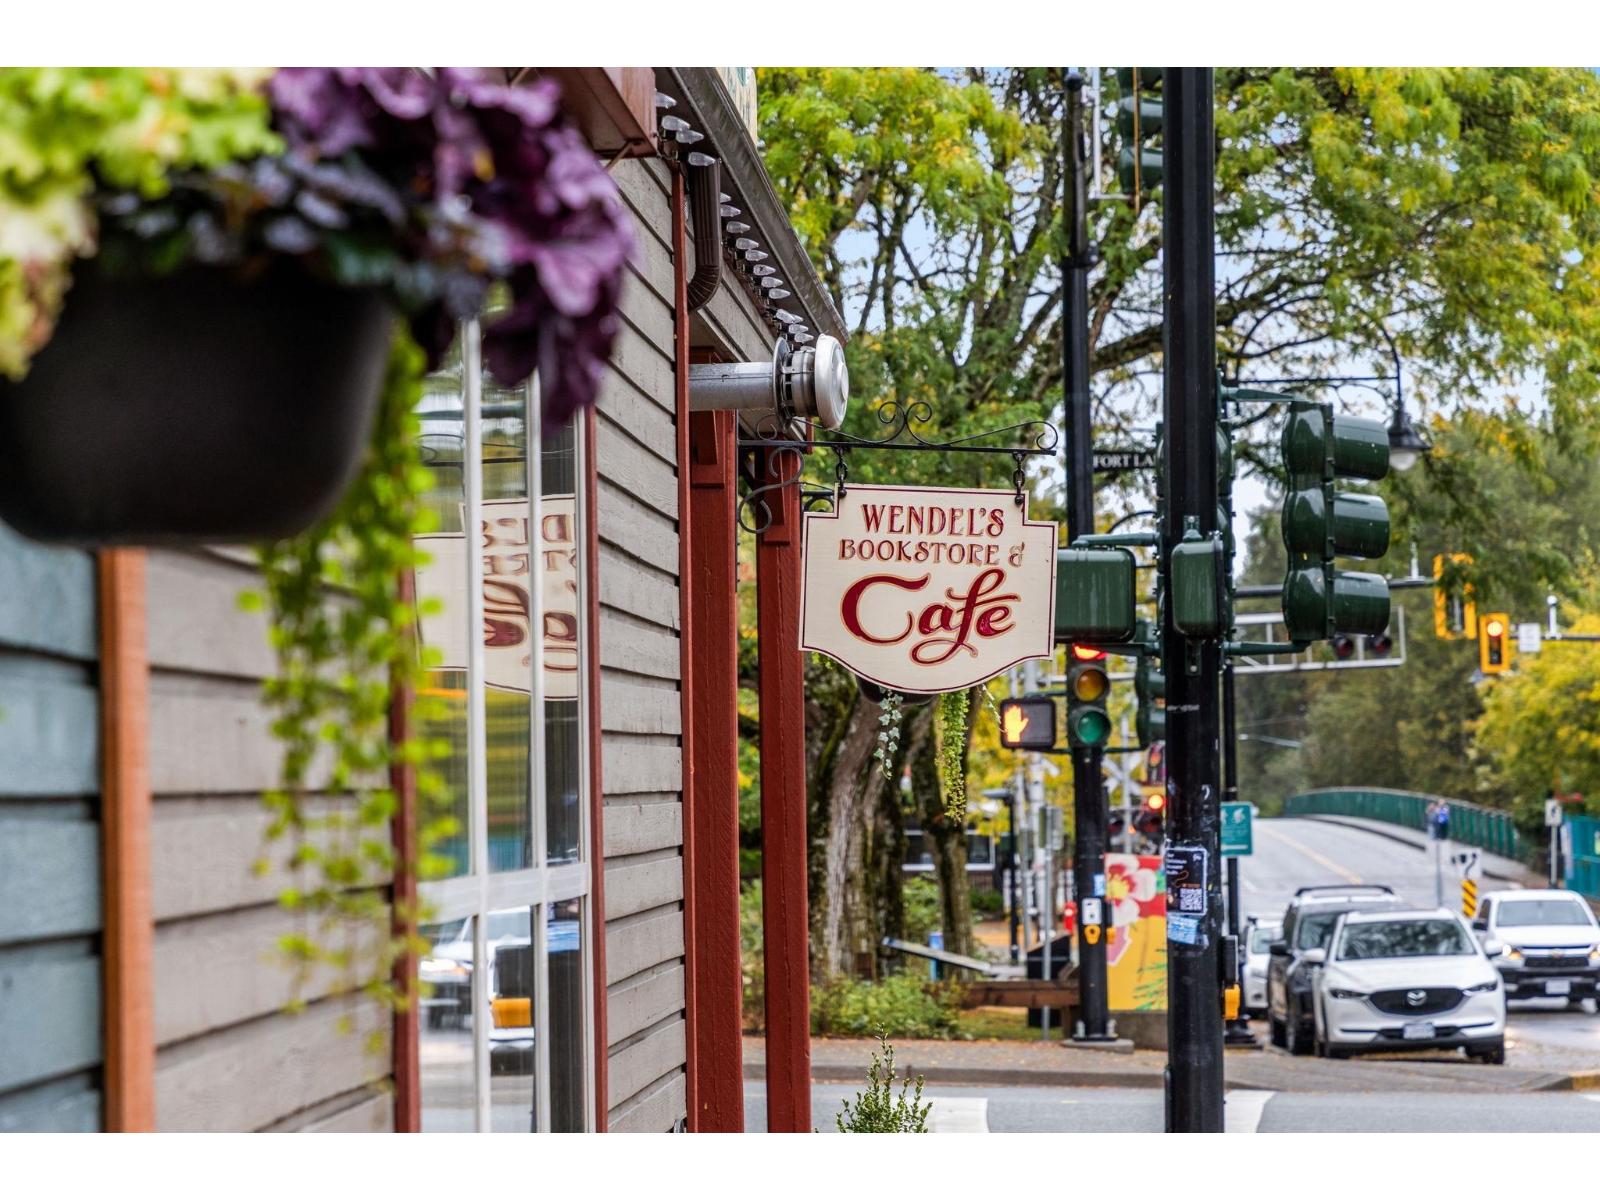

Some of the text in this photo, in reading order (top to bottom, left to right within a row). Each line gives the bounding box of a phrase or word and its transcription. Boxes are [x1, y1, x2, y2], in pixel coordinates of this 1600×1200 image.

[861, 504, 1004, 537] WENDEL'S
[838, 539, 1025, 567] BOOKSTORE &
[840, 568, 1021, 666] Cafe
